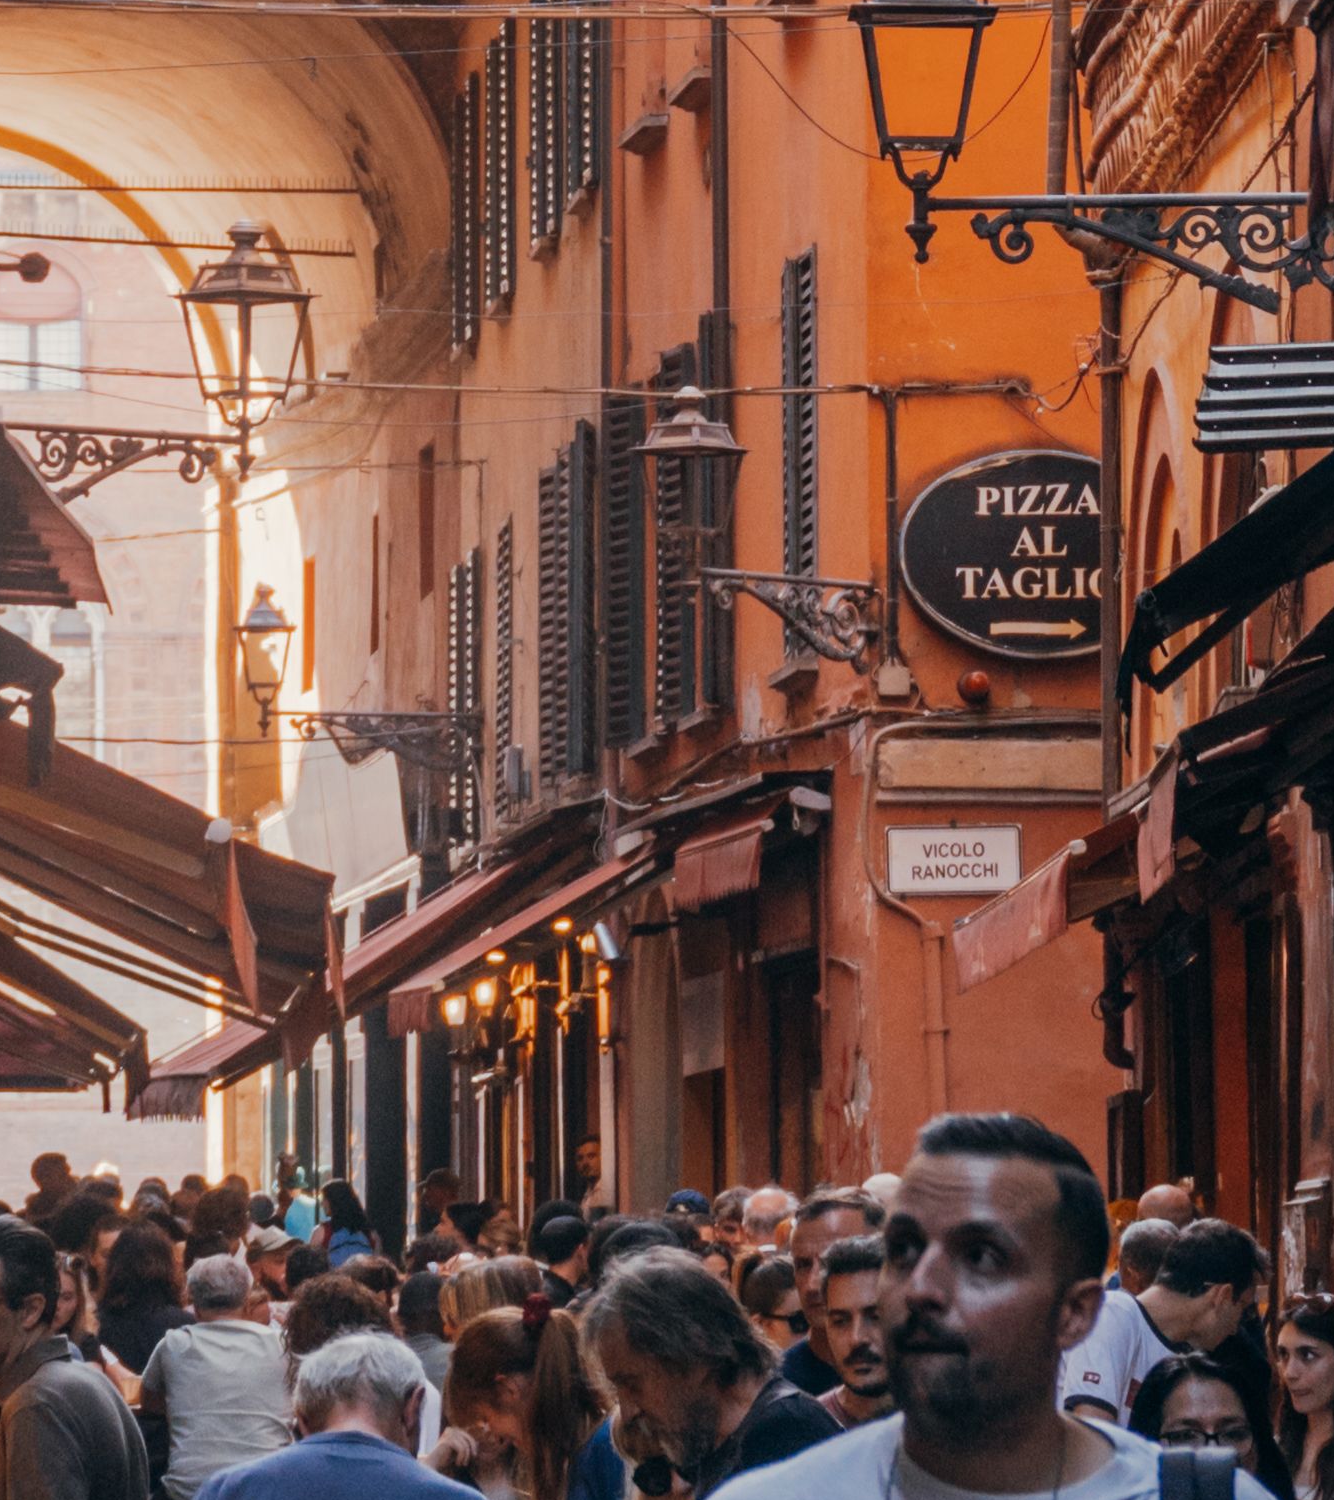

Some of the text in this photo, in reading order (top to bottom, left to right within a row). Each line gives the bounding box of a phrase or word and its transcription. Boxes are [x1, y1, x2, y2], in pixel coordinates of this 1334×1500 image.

[974, 484, 1102, 517] PIZZA
[1010, 525, 1068, 558] AL
[921, 842, 986, 859] VICOLO
[910, 861, 1000, 881] RANOCCHI
